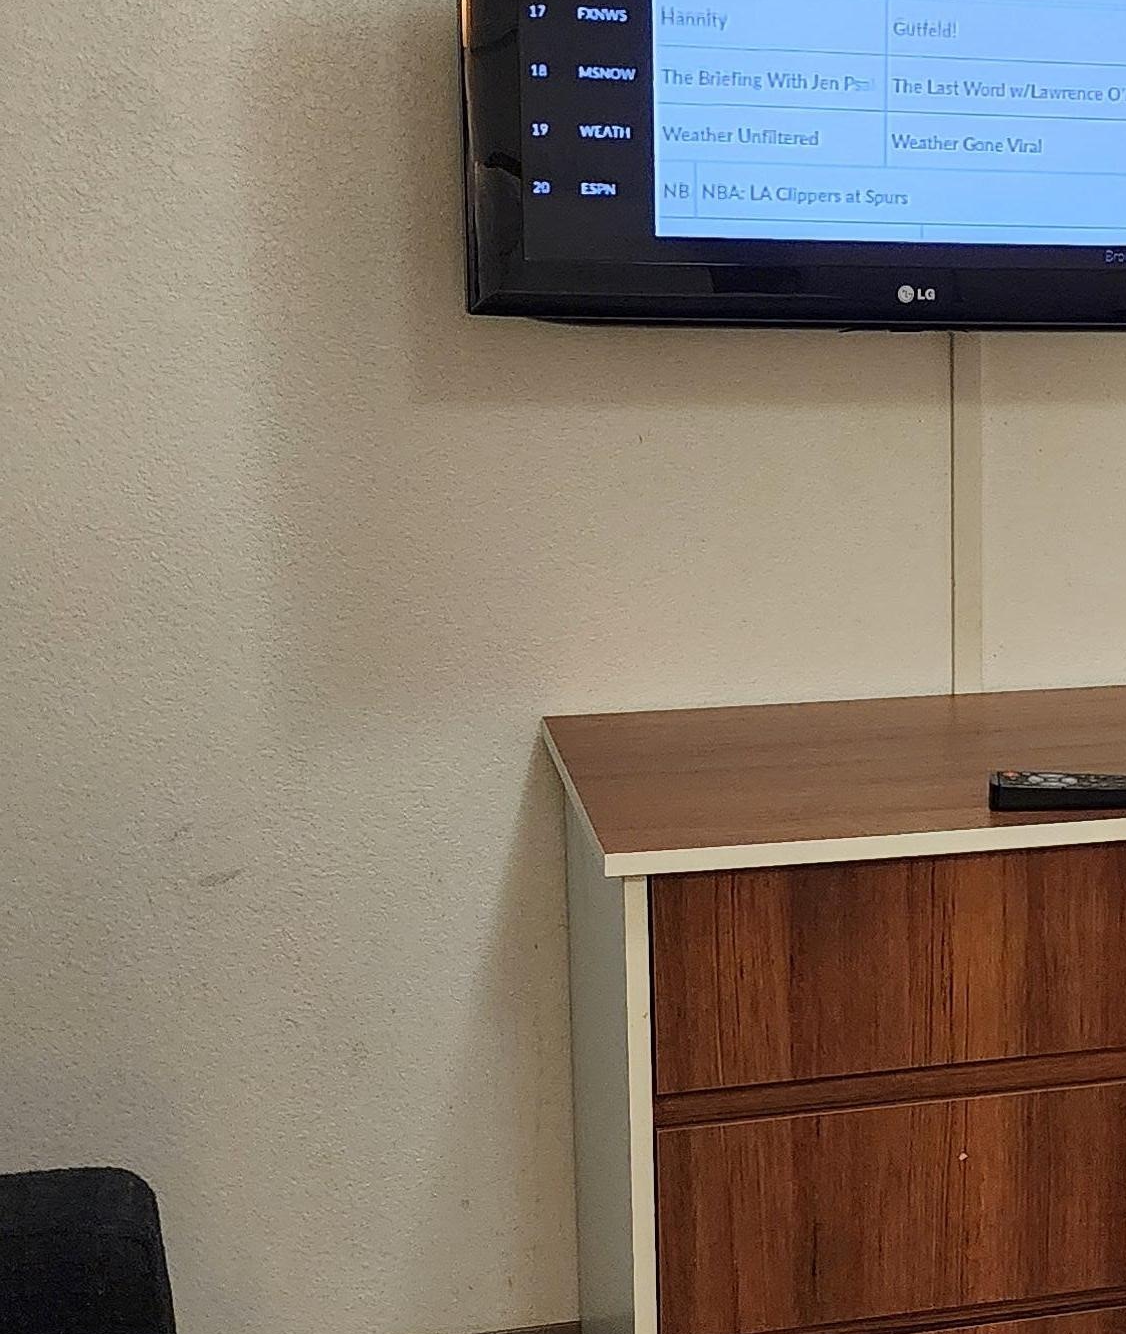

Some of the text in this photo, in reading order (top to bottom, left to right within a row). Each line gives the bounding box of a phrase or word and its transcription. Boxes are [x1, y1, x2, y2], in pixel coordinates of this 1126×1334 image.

[528, 5, 546, 18] 17
[576, 6, 628, 22] FXNWS
[660, 6, 728, 31] Hannity
[893, 20, 957, 38] Gutfeld!
[530, 64, 548, 77] 18
[578, 65, 636, 80] MSNOW
[662, 69, 693, 85] The
[699, 70, 762, 90] Briefing
[767, 72, 808, 90] With
[811, 74, 839, 92] Jen
[892, 78, 922, 95] The
[927, 79, 959, 97] Last
[963, 81, 1005, 98] Word
[1010, 83, 1103, 101] w/Lawrence
[531, 123, 549, 136] 19
[579, 125, 631, 139] WEATH
[662, 125, 819, 146] Weather Unfiltered
[892, 133, 1042, 153] Weather Gone Viral
[532, 181, 551, 194] 20
[581, 182, 616, 196] ESPN
[663, 184, 690, 199] NB
[702, 184, 909, 207] NBA: LA Clippers at Spurs
[917, 287, 936, 301] LG
